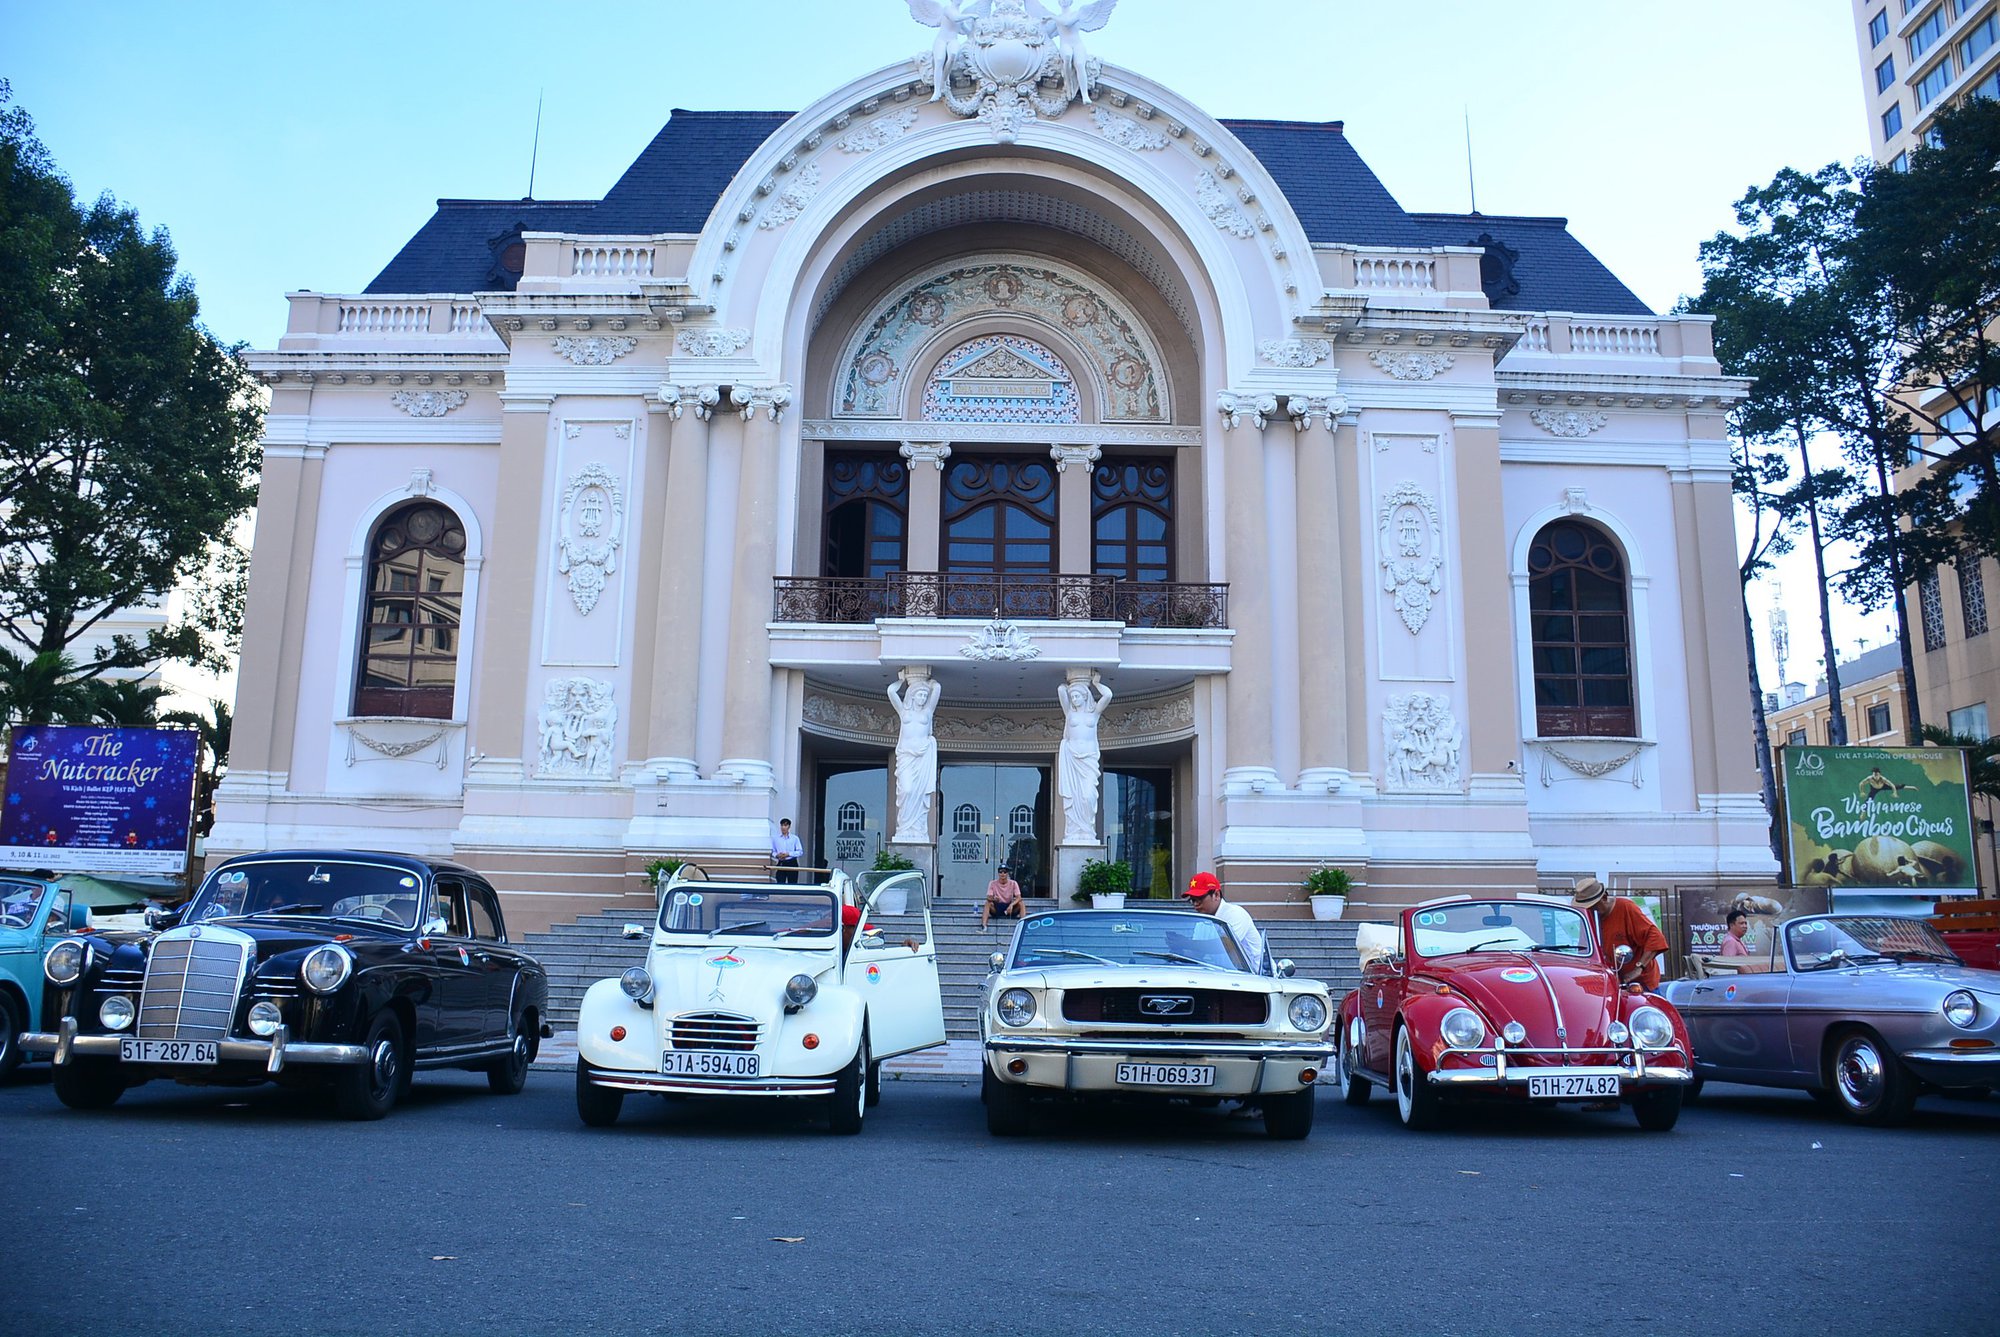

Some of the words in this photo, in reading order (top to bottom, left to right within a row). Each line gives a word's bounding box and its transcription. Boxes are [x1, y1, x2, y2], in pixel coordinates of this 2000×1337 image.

[84, 733, 123, 757] The
[1835, 752, 1851, 760] LIVE
[1852, 752, 1862, 760] AT
[39, 758, 163, 787] Nutcracker
[1841, 791, 1922, 817] Vietnamese
[1810, 806, 1905, 840] Bamboo
[1906, 814, 1953, 838] Circus
[951, 841, 981, 849] SAIGON
[1717, 933, 1757, 945] SW
[123, 1041, 216, 1062] 51F-287.64
[664, 1053, 757, 1075] 51A-594.08
[1119, 1065, 1209, 1084] 51H-069.31
[1531, 1077, 1617, 1096] 51H-274.82
